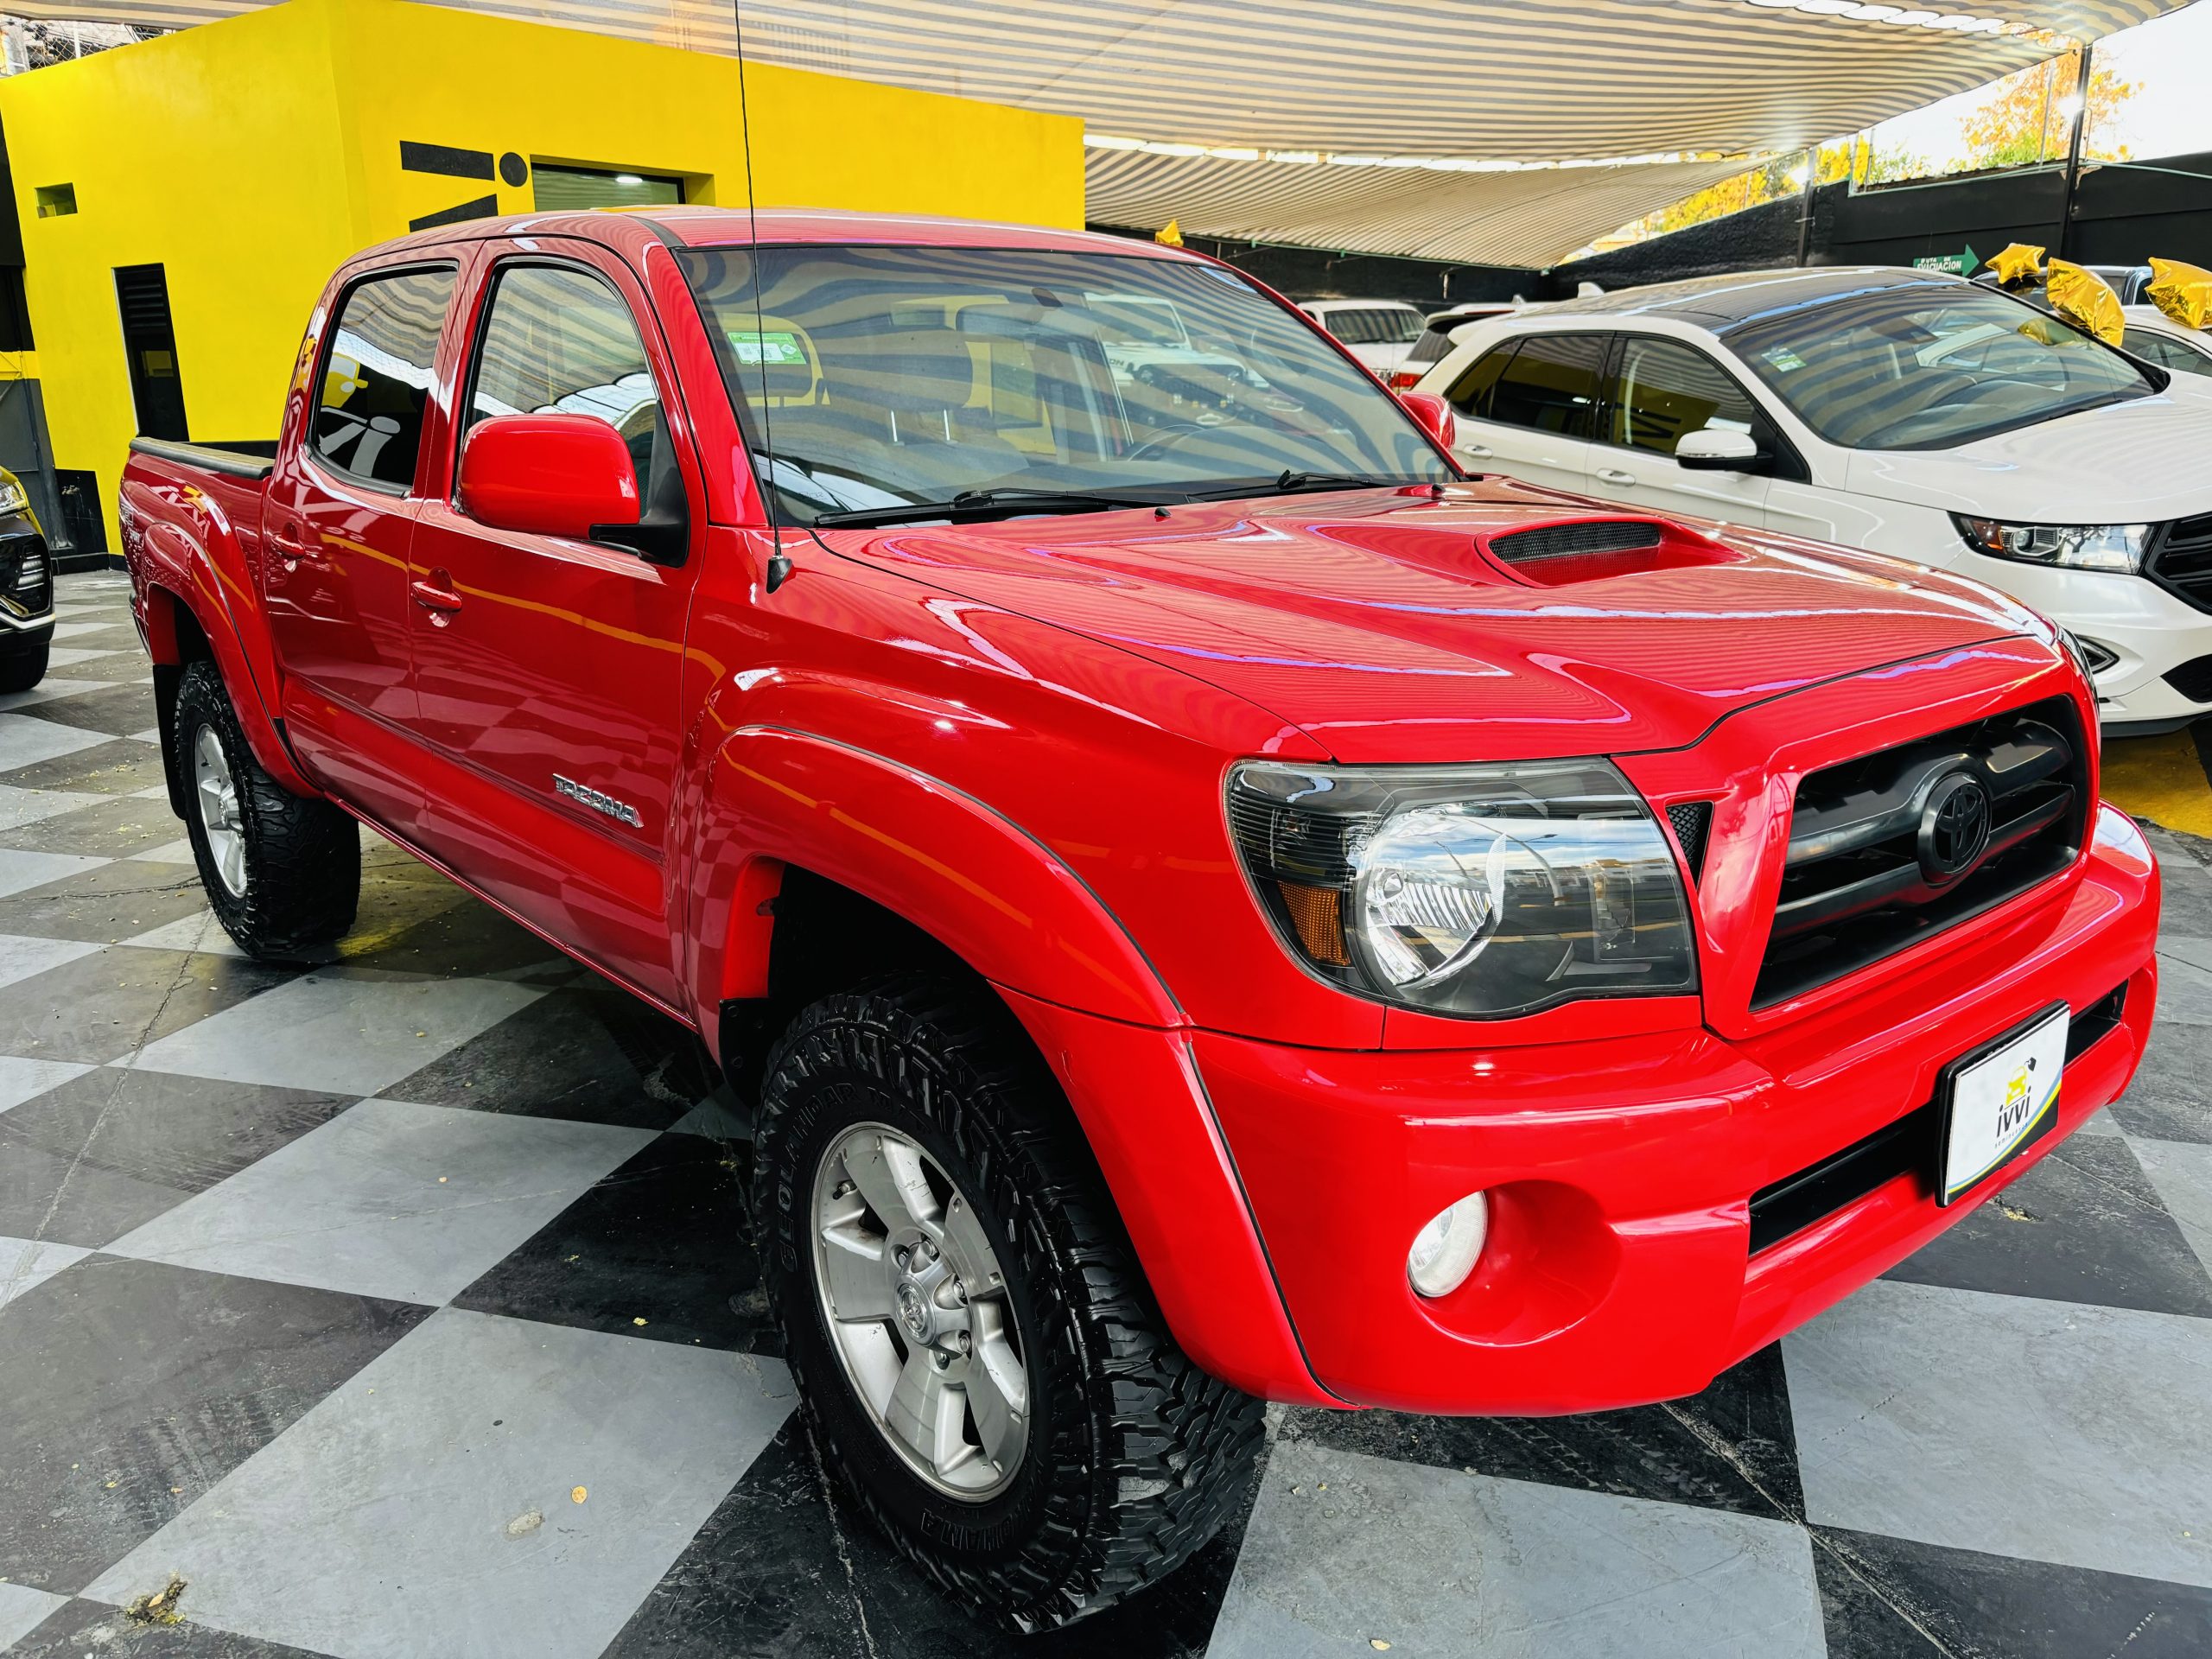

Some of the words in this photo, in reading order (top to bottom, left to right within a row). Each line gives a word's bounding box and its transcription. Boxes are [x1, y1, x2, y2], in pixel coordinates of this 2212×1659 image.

[1916, 260, 1962, 271] EVACUACION
[552, 772, 645, 829] TACOMA
[1996, 1085, 2031, 1138] ivvi
